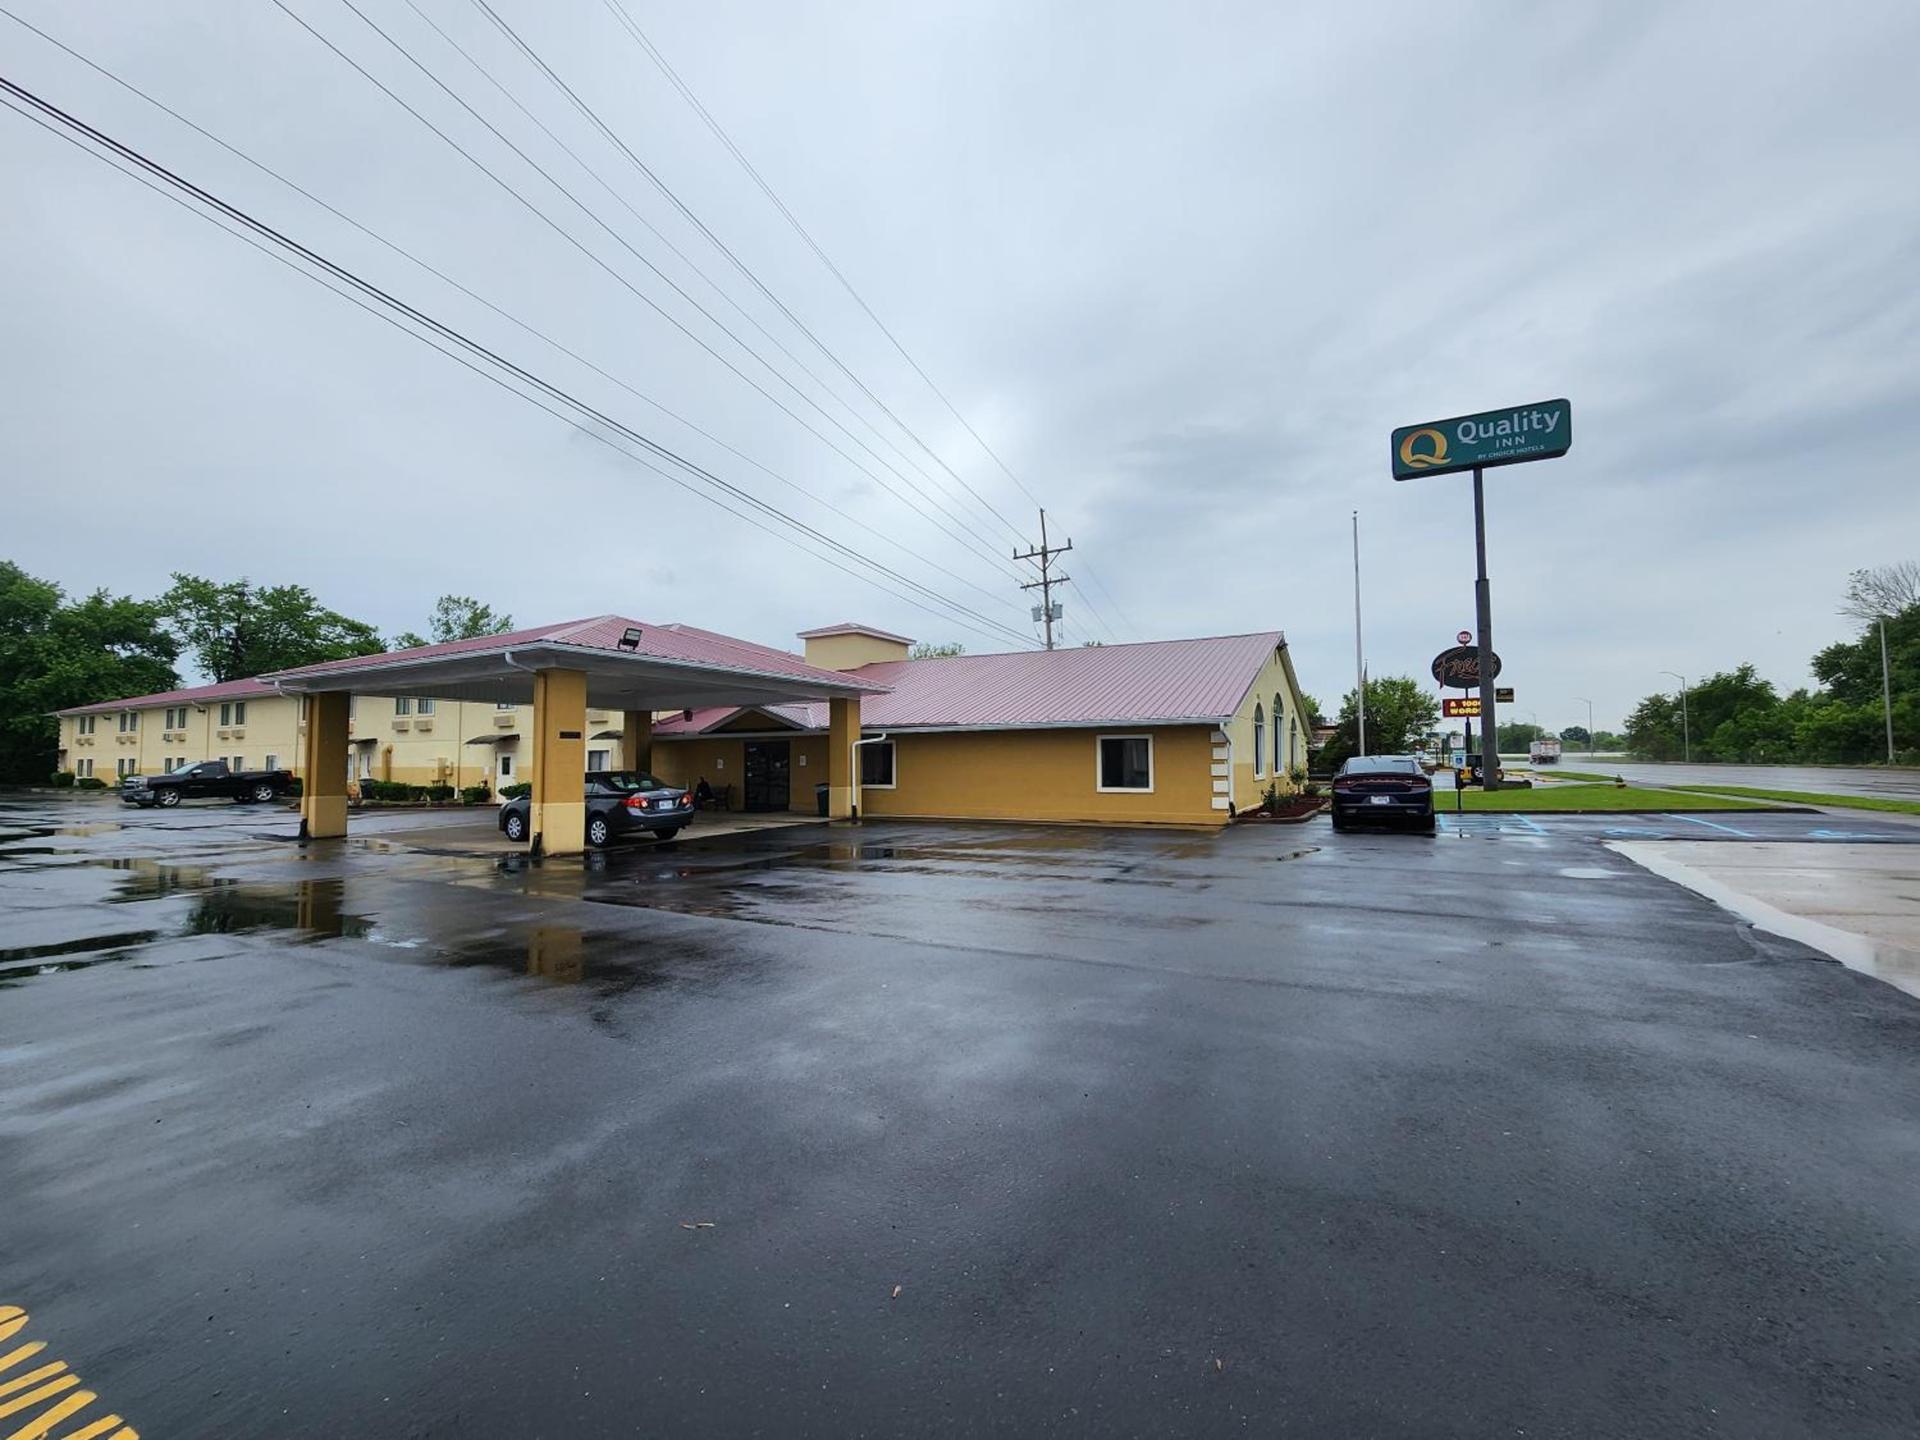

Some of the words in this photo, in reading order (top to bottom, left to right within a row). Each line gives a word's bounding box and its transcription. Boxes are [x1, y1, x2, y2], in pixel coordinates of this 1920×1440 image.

[1457, 410, 1561, 444] Quality
[1400, 428, 1452, 468] Q
[1488, 450, 1515, 458] CHOICE
[1516, 445, 1545, 454] HOTELS
[1496, 435, 1525, 448] INN
